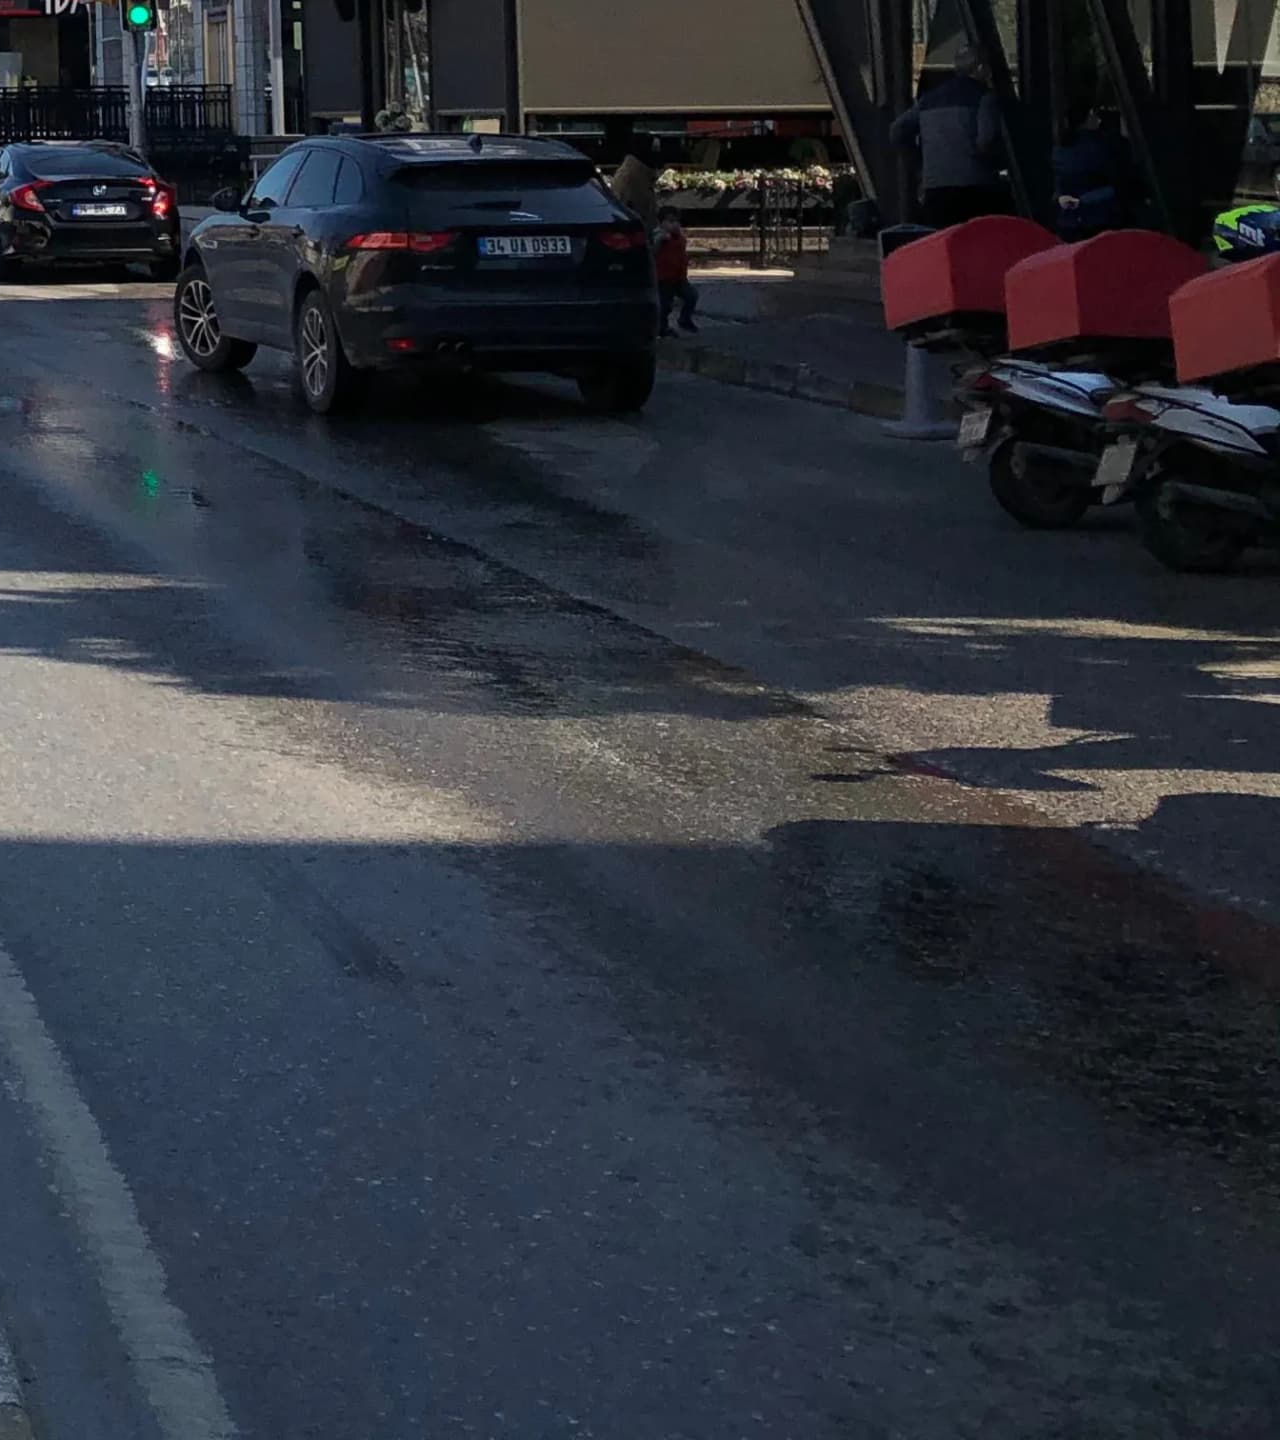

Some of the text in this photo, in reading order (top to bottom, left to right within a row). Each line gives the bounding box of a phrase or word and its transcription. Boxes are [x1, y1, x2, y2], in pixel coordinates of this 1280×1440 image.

[487, 238, 567, 254] 34 UA 0933
